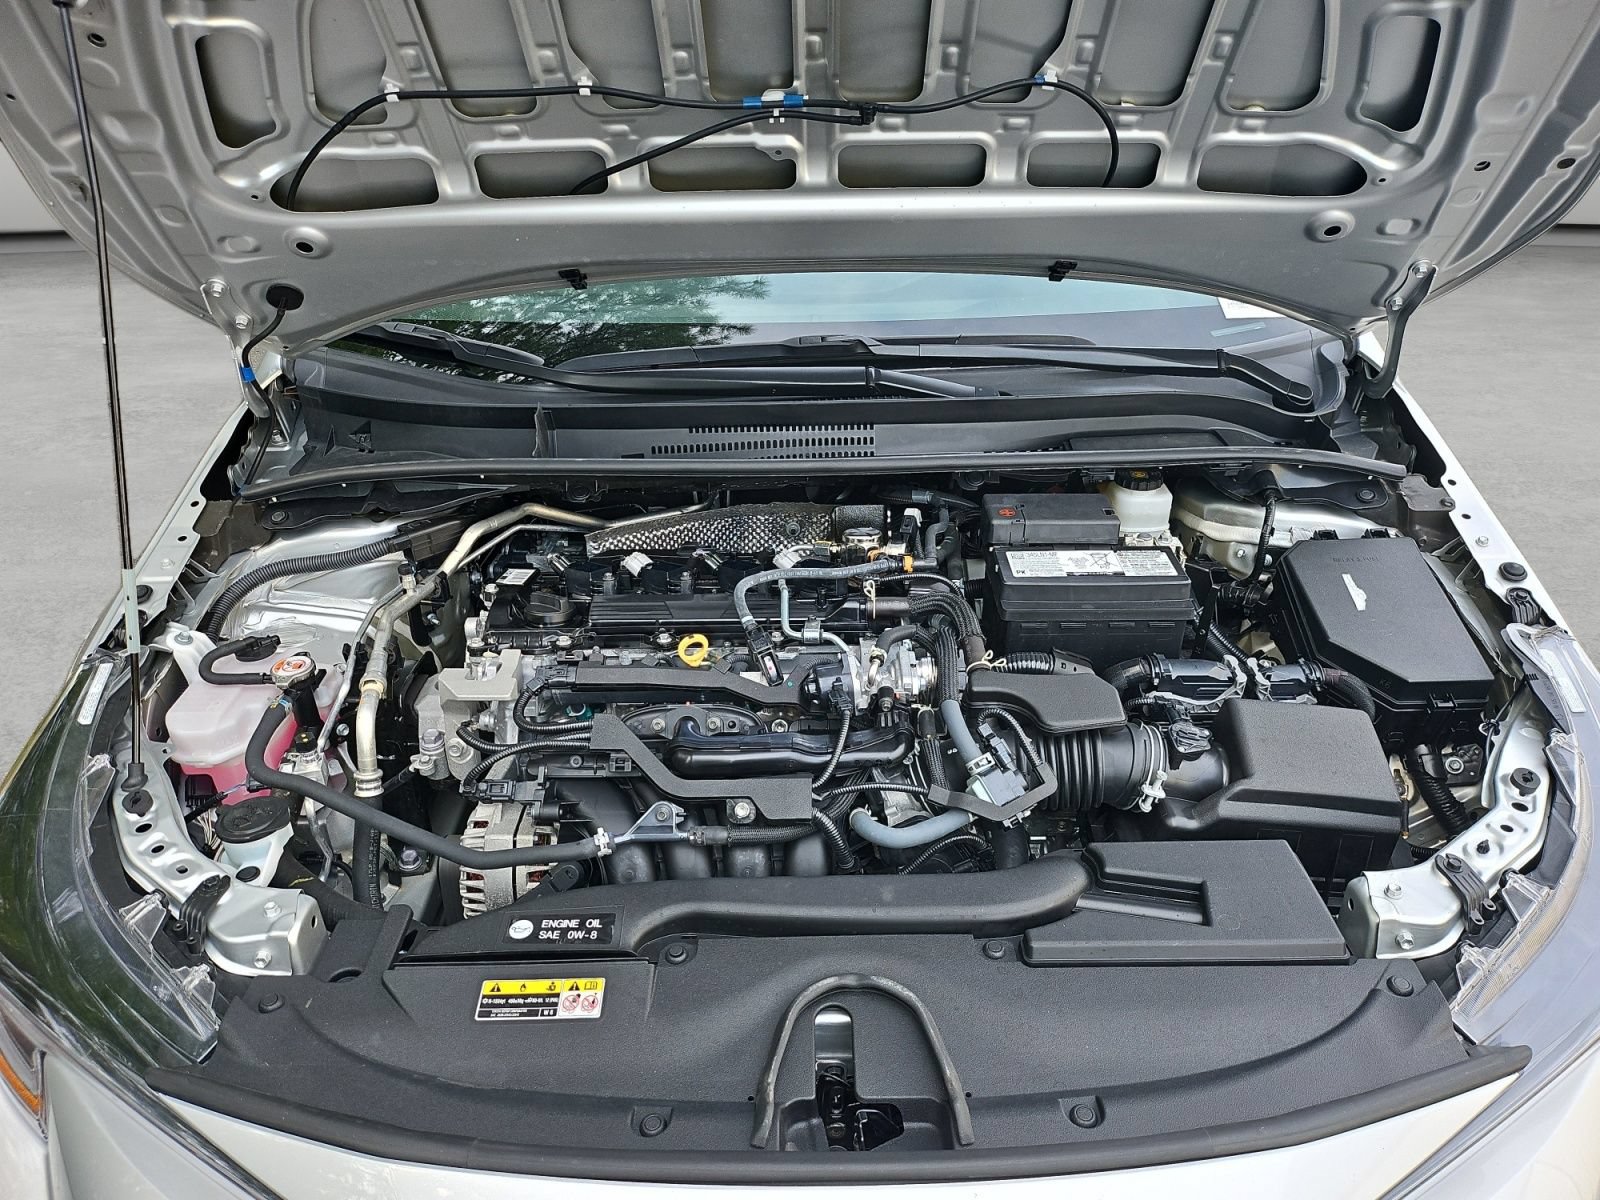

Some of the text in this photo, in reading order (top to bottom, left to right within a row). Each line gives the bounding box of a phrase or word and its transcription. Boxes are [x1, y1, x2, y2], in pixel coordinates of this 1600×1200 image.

[541, 918, 603, 928] ENGINE OIL
[538, 930, 598, 940] SAE 0W-8
